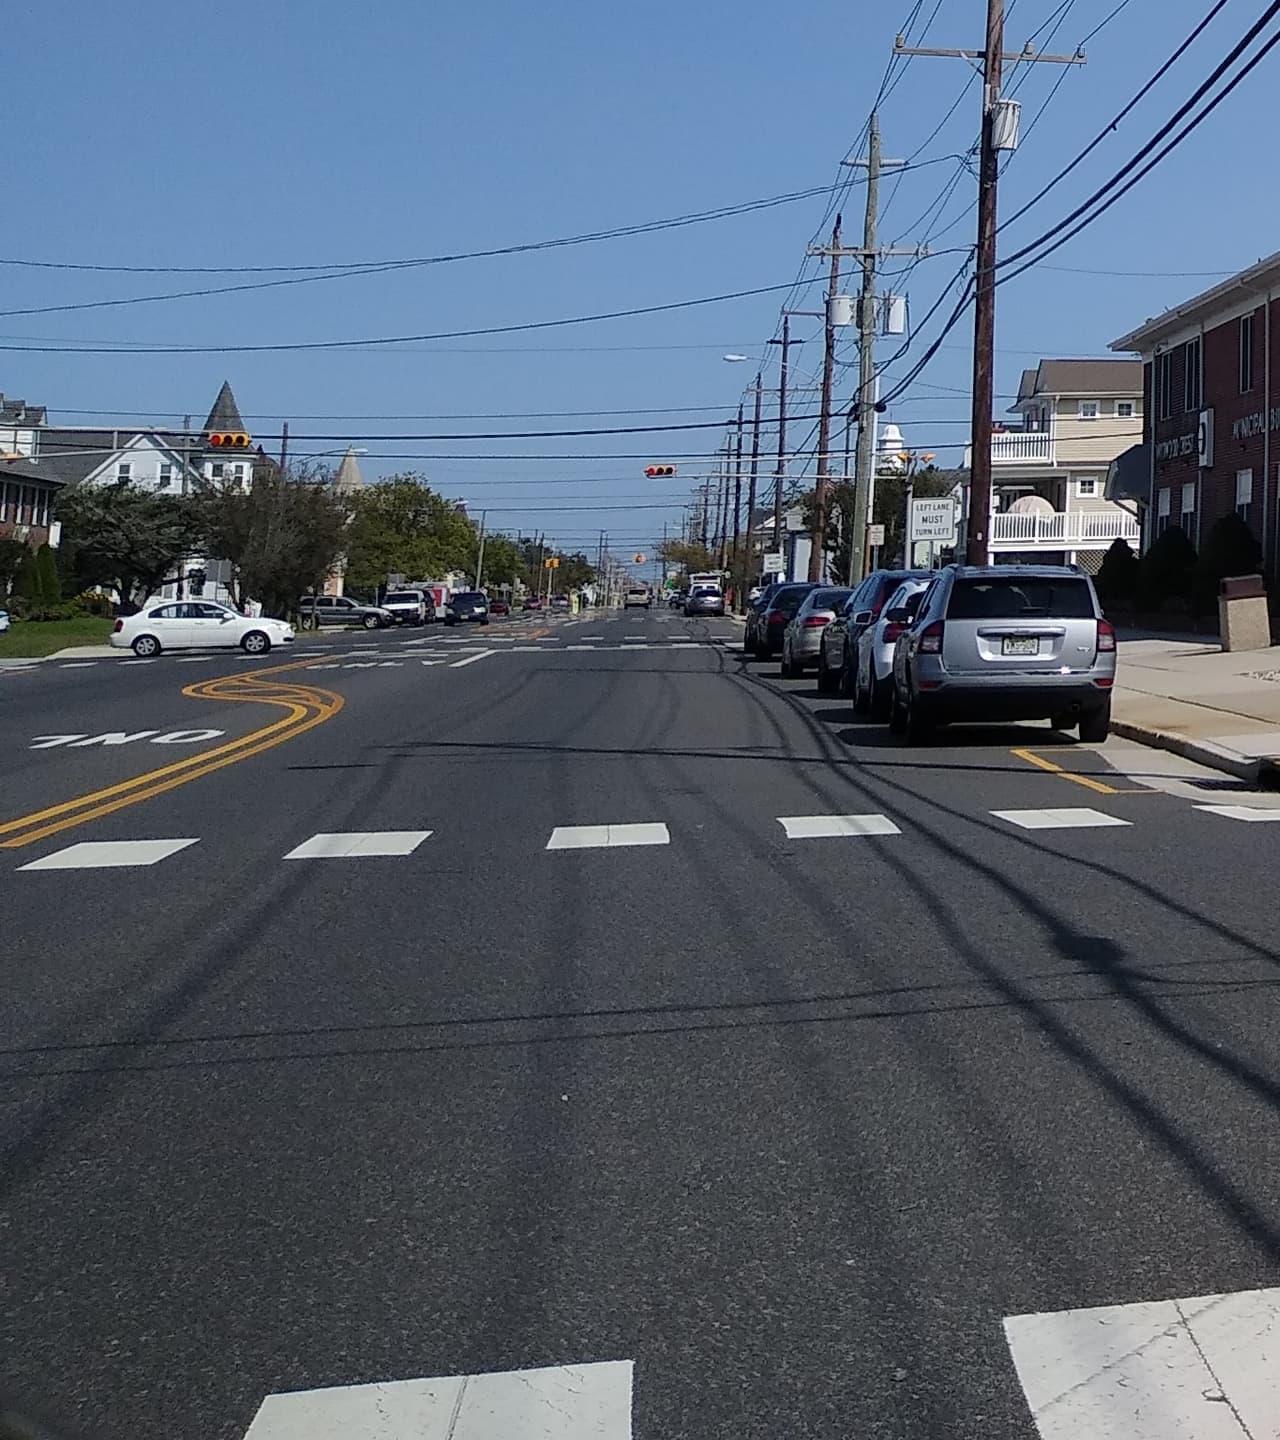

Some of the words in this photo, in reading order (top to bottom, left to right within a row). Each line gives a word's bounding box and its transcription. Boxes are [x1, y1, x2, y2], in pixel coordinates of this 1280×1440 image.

[916, 503, 932, 511] LEFT
[933, 503, 950, 511] LANE
[921, 514, 944, 524] MUST
[915, 528, 933, 536] TURN
[934, 527, 949, 536] LEFT
